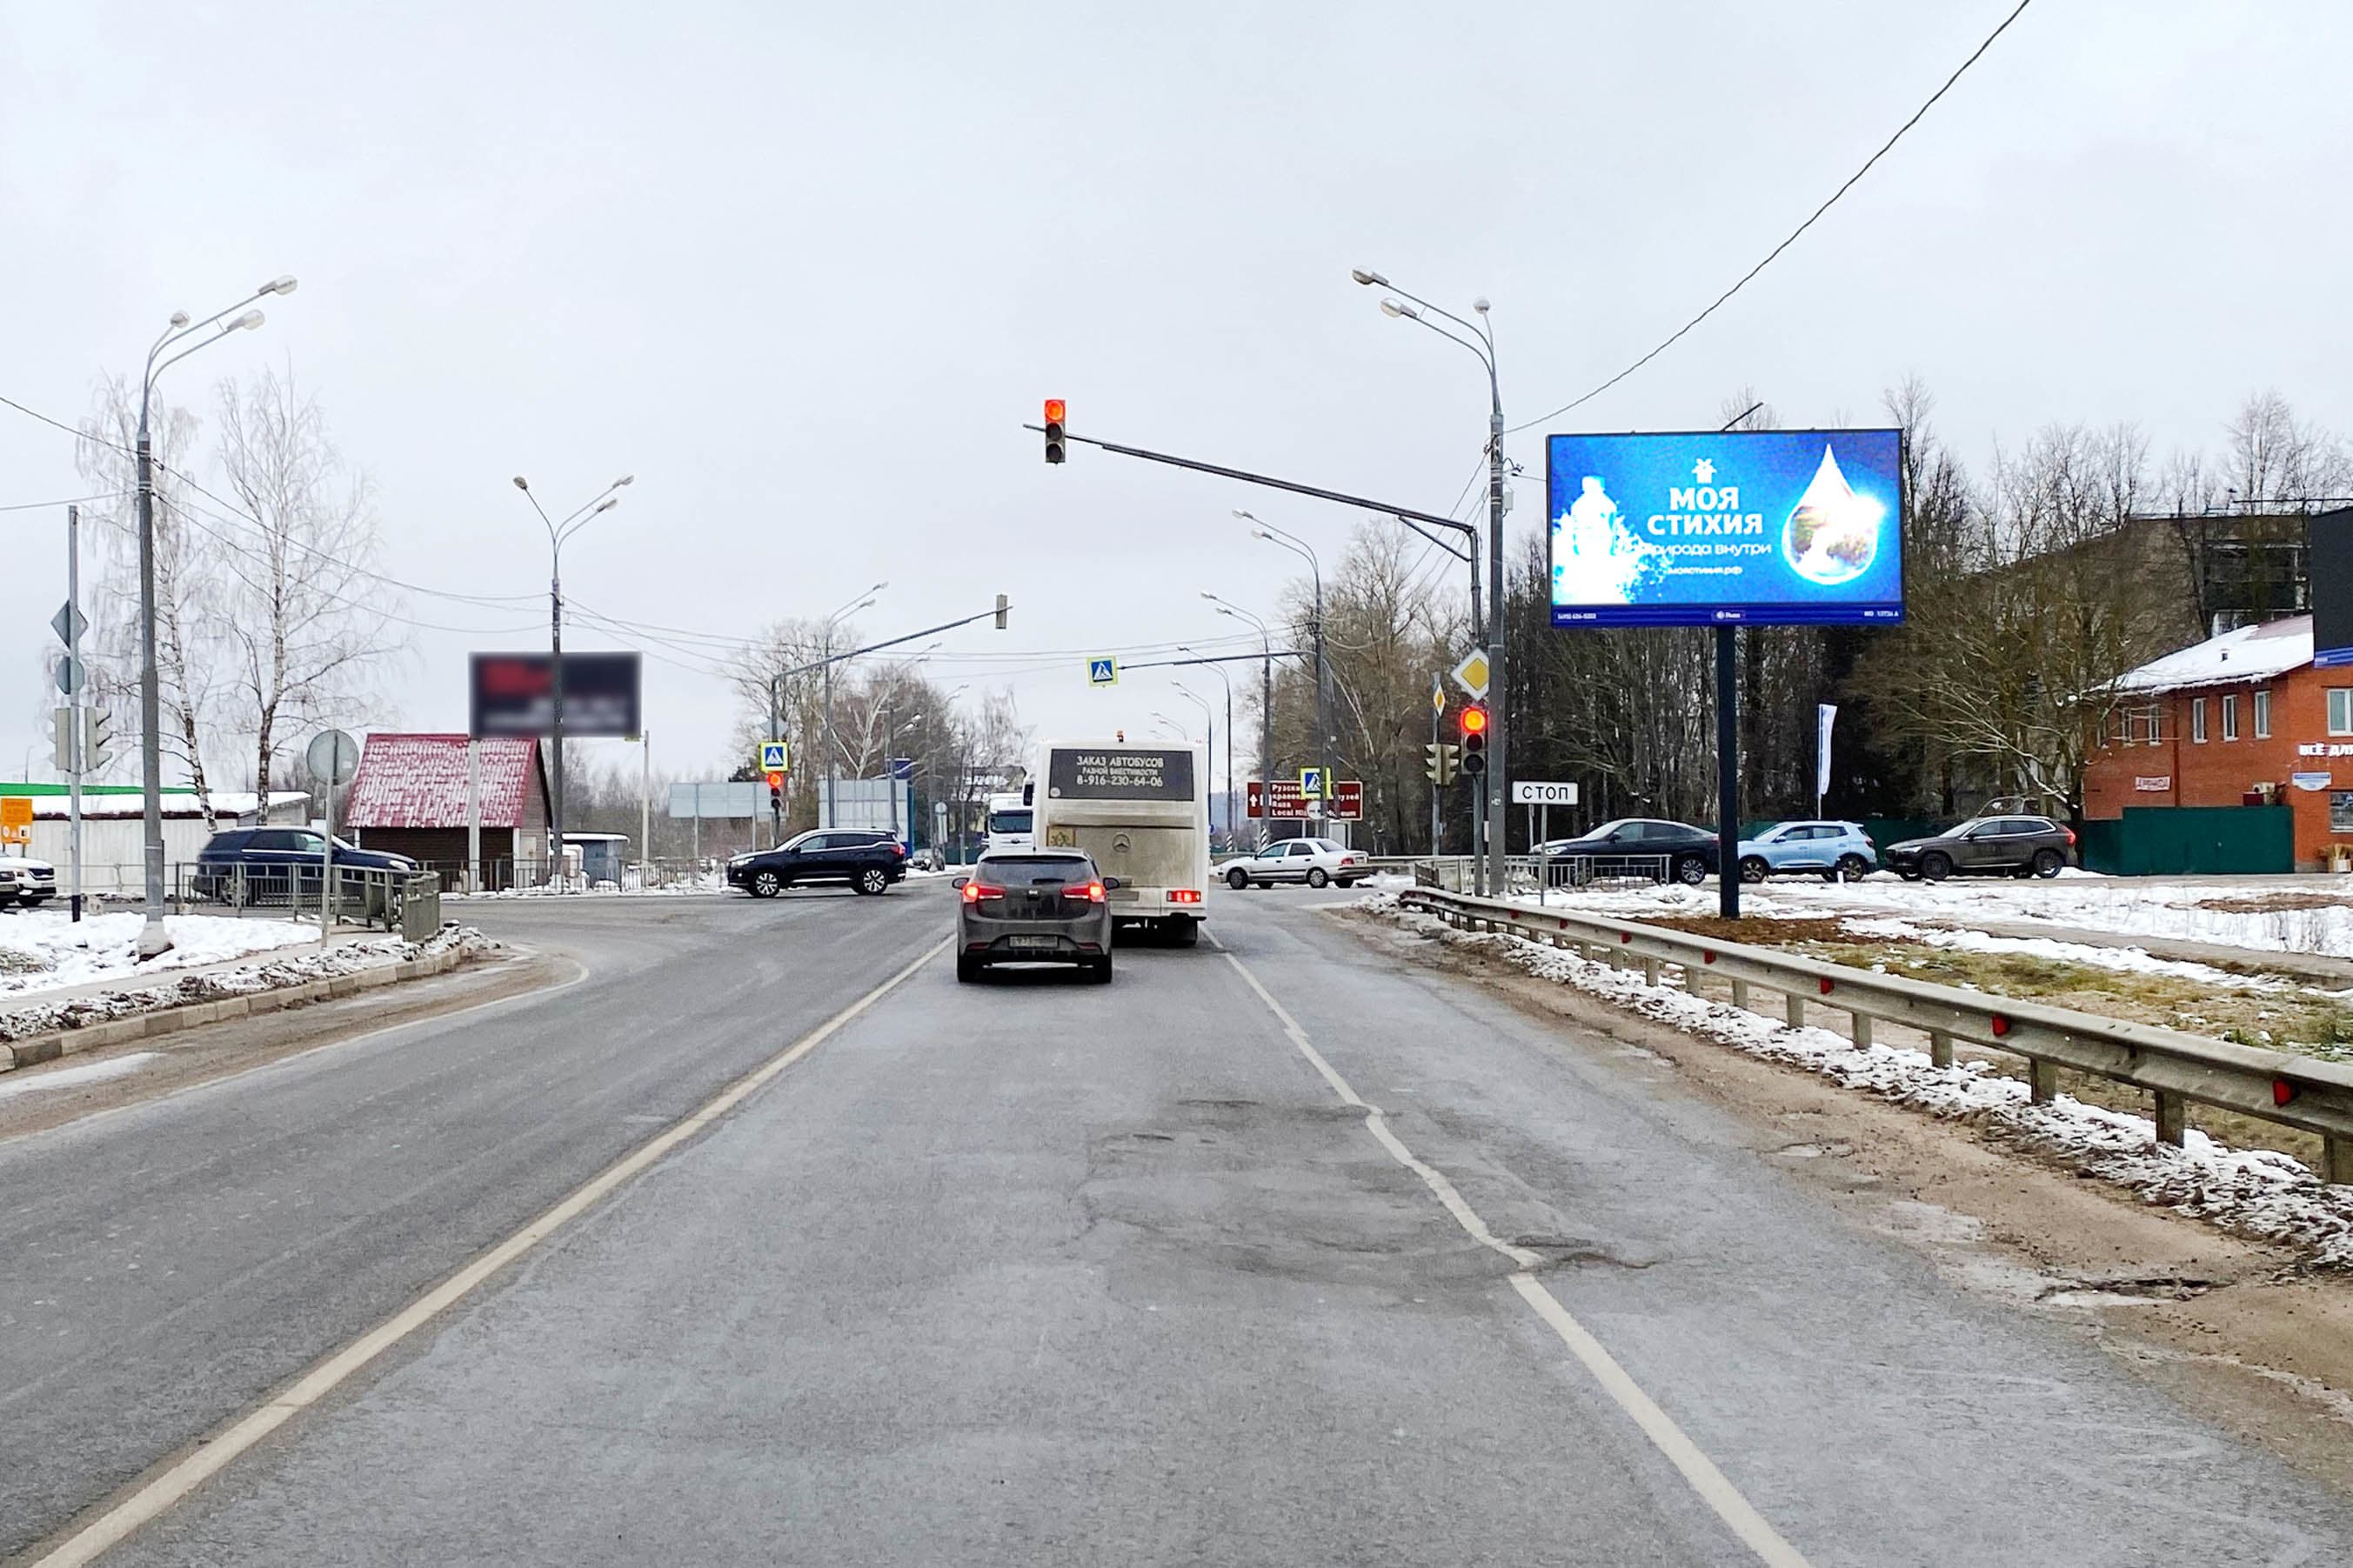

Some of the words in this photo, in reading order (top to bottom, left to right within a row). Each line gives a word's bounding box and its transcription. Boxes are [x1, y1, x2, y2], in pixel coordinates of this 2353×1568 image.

[1669, 486, 1739, 511] МОЯ
[1647, 513, 1762, 536] СТИХИЯ
[1643, 544, 1713, 557] рирода
[1715, 543, 1772, 557] внутри
[1077, 756, 1106, 765] ЗАКАЗ
[1109, 757, 1164, 768] АВТОБУСОВ
[1077, 774, 1163, 787] 8-916-230-64-06
[1522, 785, 1568, 800] СТОП
